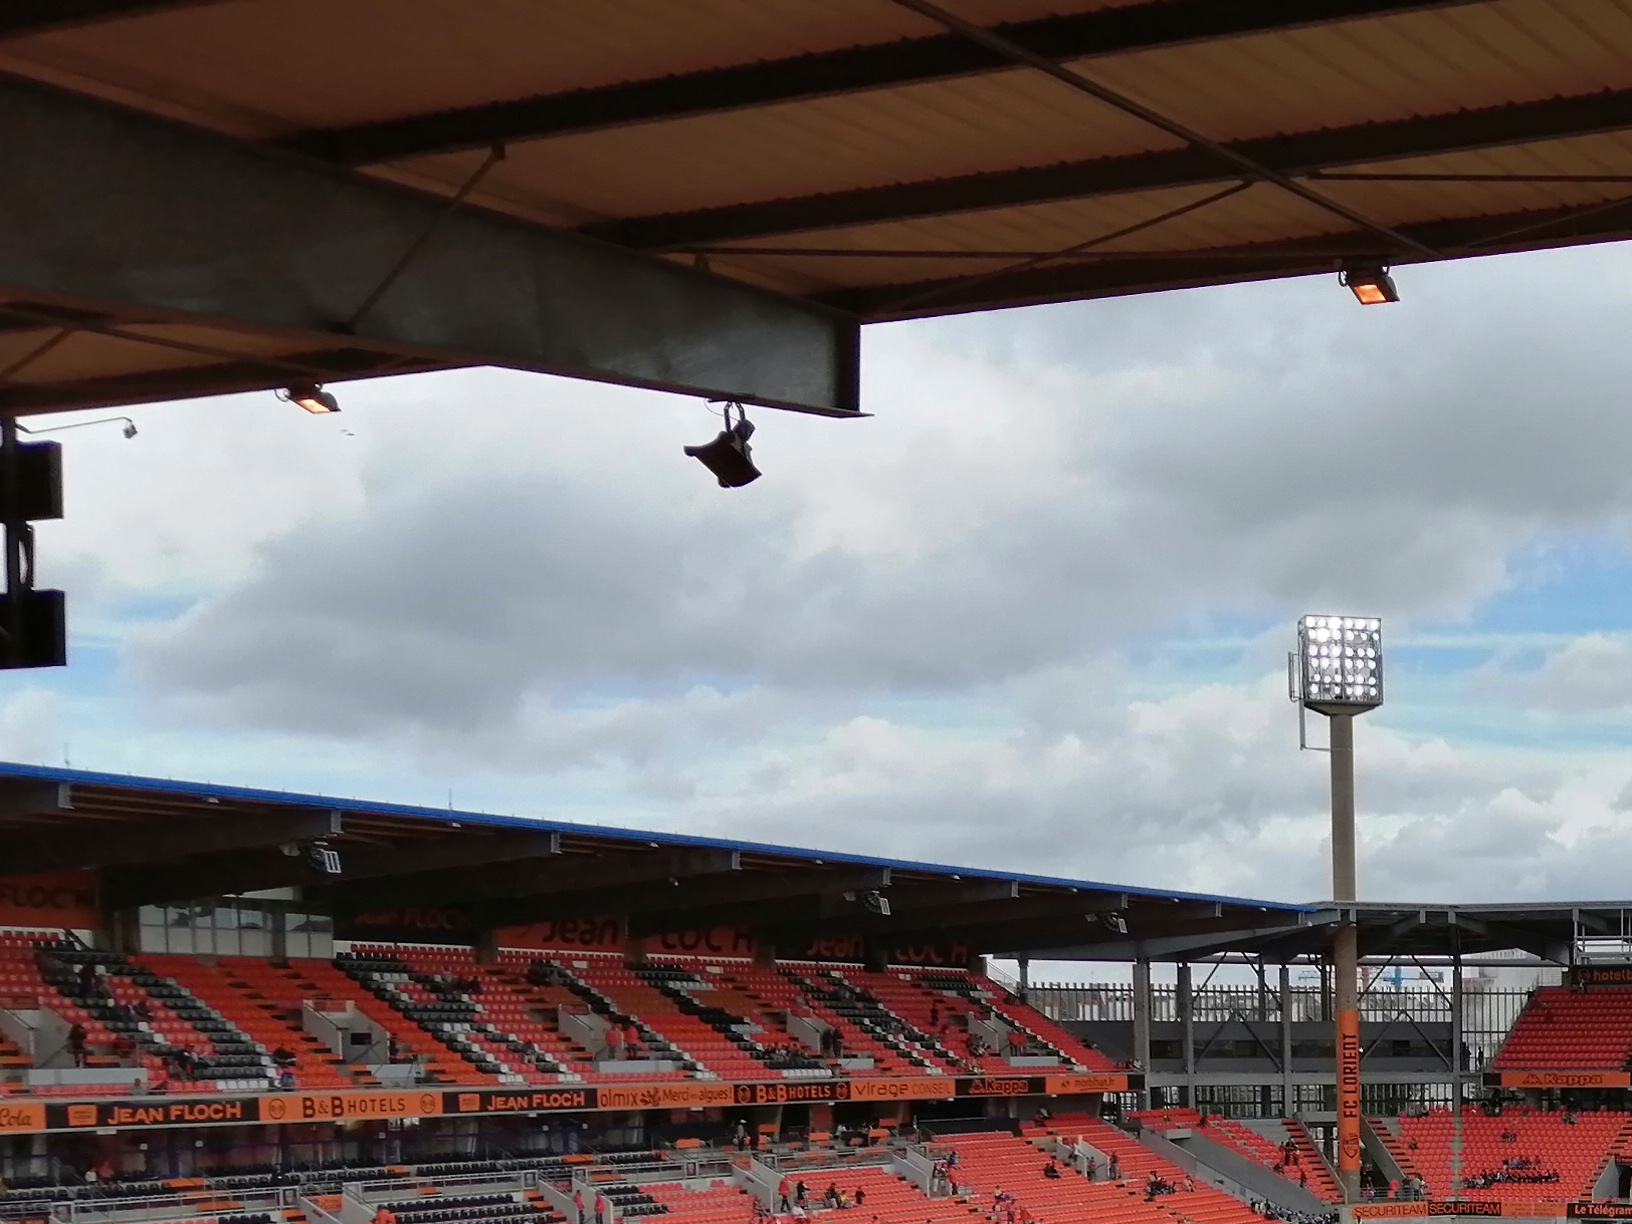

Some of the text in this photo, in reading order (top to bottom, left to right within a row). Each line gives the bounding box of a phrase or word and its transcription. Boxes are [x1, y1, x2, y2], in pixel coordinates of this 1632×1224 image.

[1342, 1033, 1358, 1118] FC LORIENT
[1545, 1073, 1603, 1086] Kappa
[756, 1085, 831, 1103] B&B HOTELS
[854, 1082, 950, 1098] virage CONSEIL
[986, 1079, 1028, 1093] Kappa
[487, 1094, 529, 1111] JEAN
[601, 1088, 639, 1107] olmix
[662, 1088, 690, 1102] Merci
[107, 1106, 164, 1125] JEAN
[302, 1096, 406, 1119] B&B HOTELS
[1354, 1203, 1428, 1218] SECURITEAM
[1429, 1203, 1500, 1215] SECURITEAM
[1574, 1205, 1586, 1215] Le
